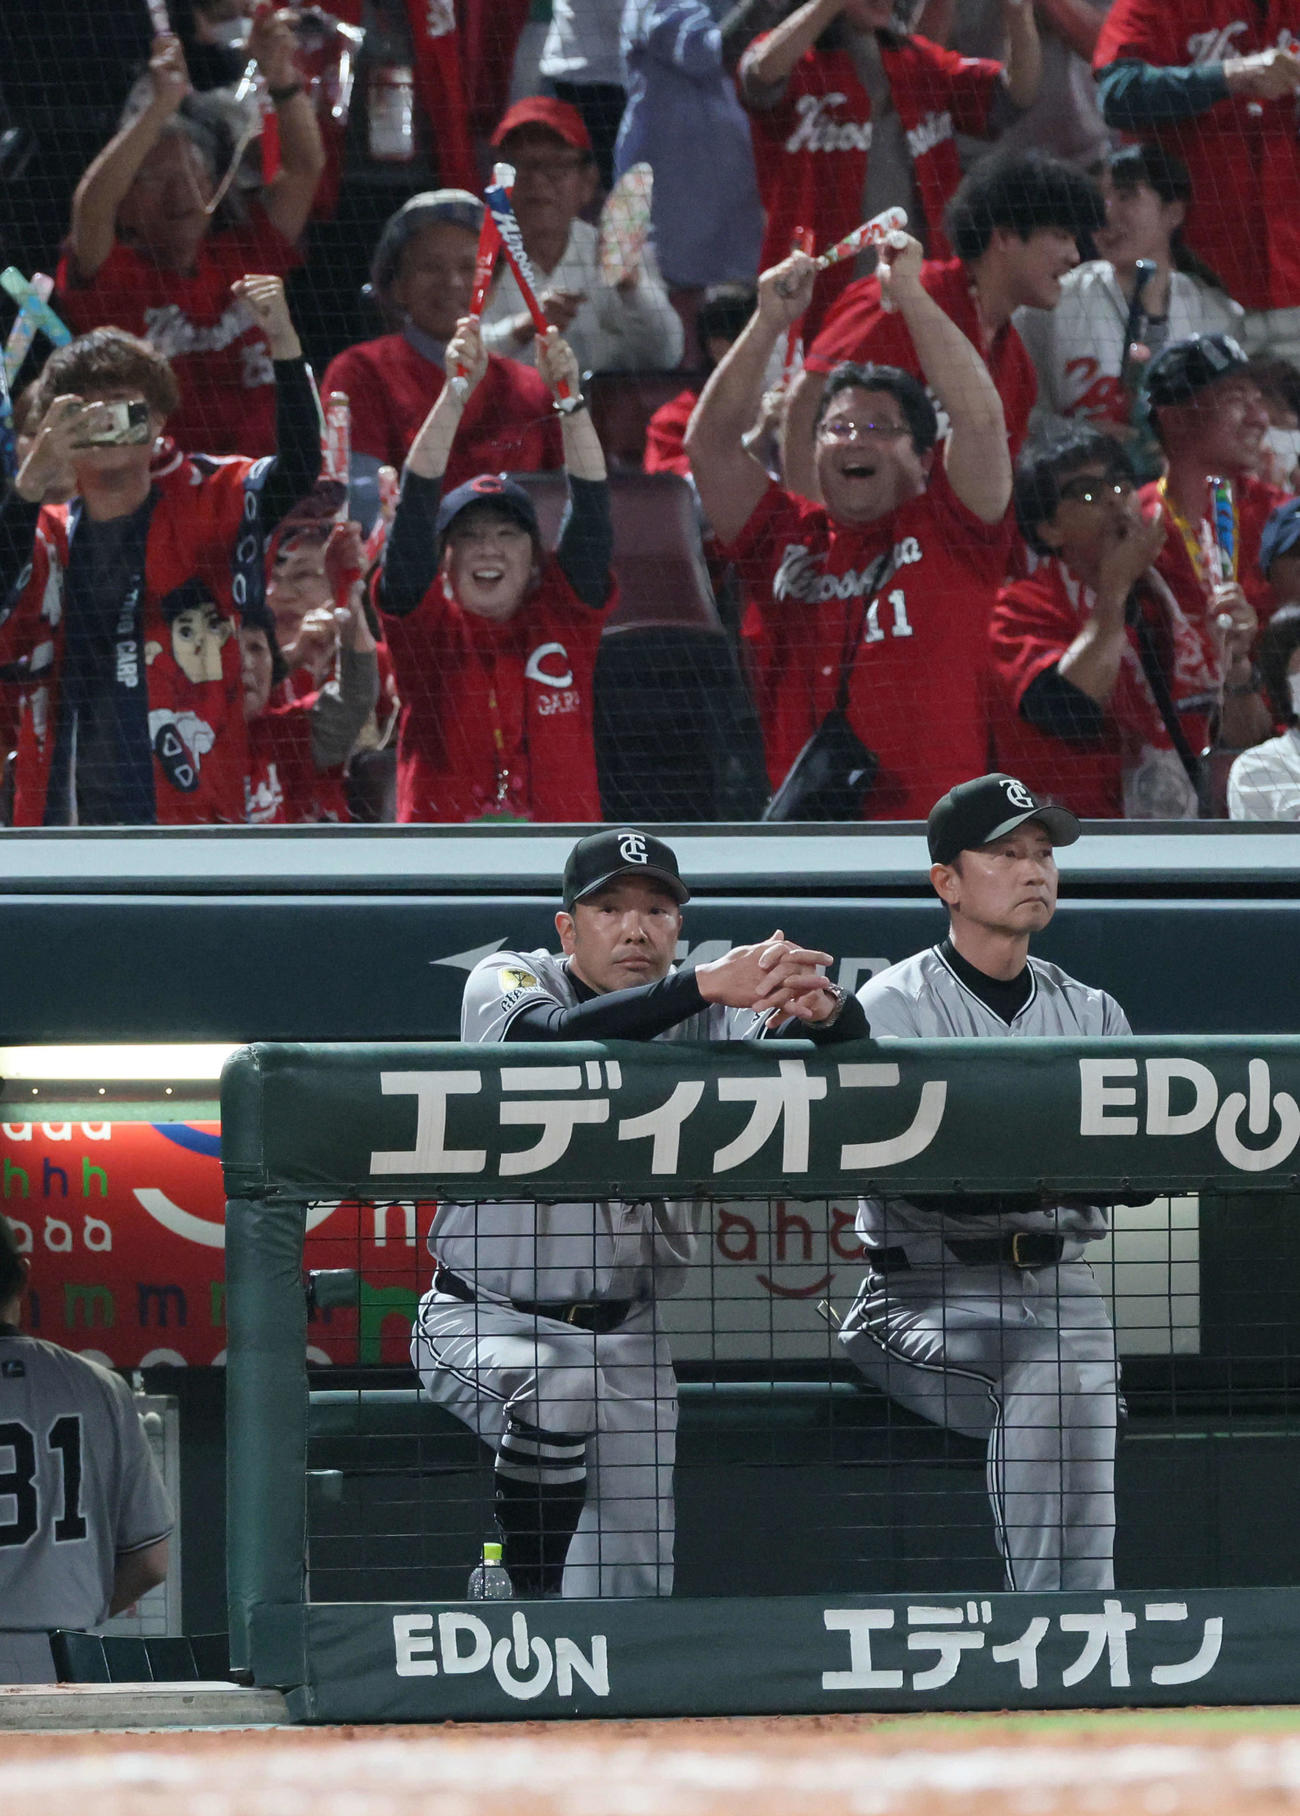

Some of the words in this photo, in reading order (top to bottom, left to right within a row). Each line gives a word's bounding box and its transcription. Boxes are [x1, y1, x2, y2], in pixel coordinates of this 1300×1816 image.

[865, 589, 913, 643] 11
[116, 640, 139, 688] CARP
[524, 641, 573, 689] C
[369, 1059, 948, 1177] エディオン
[822, 1599, 1224, 1691] エディオン
